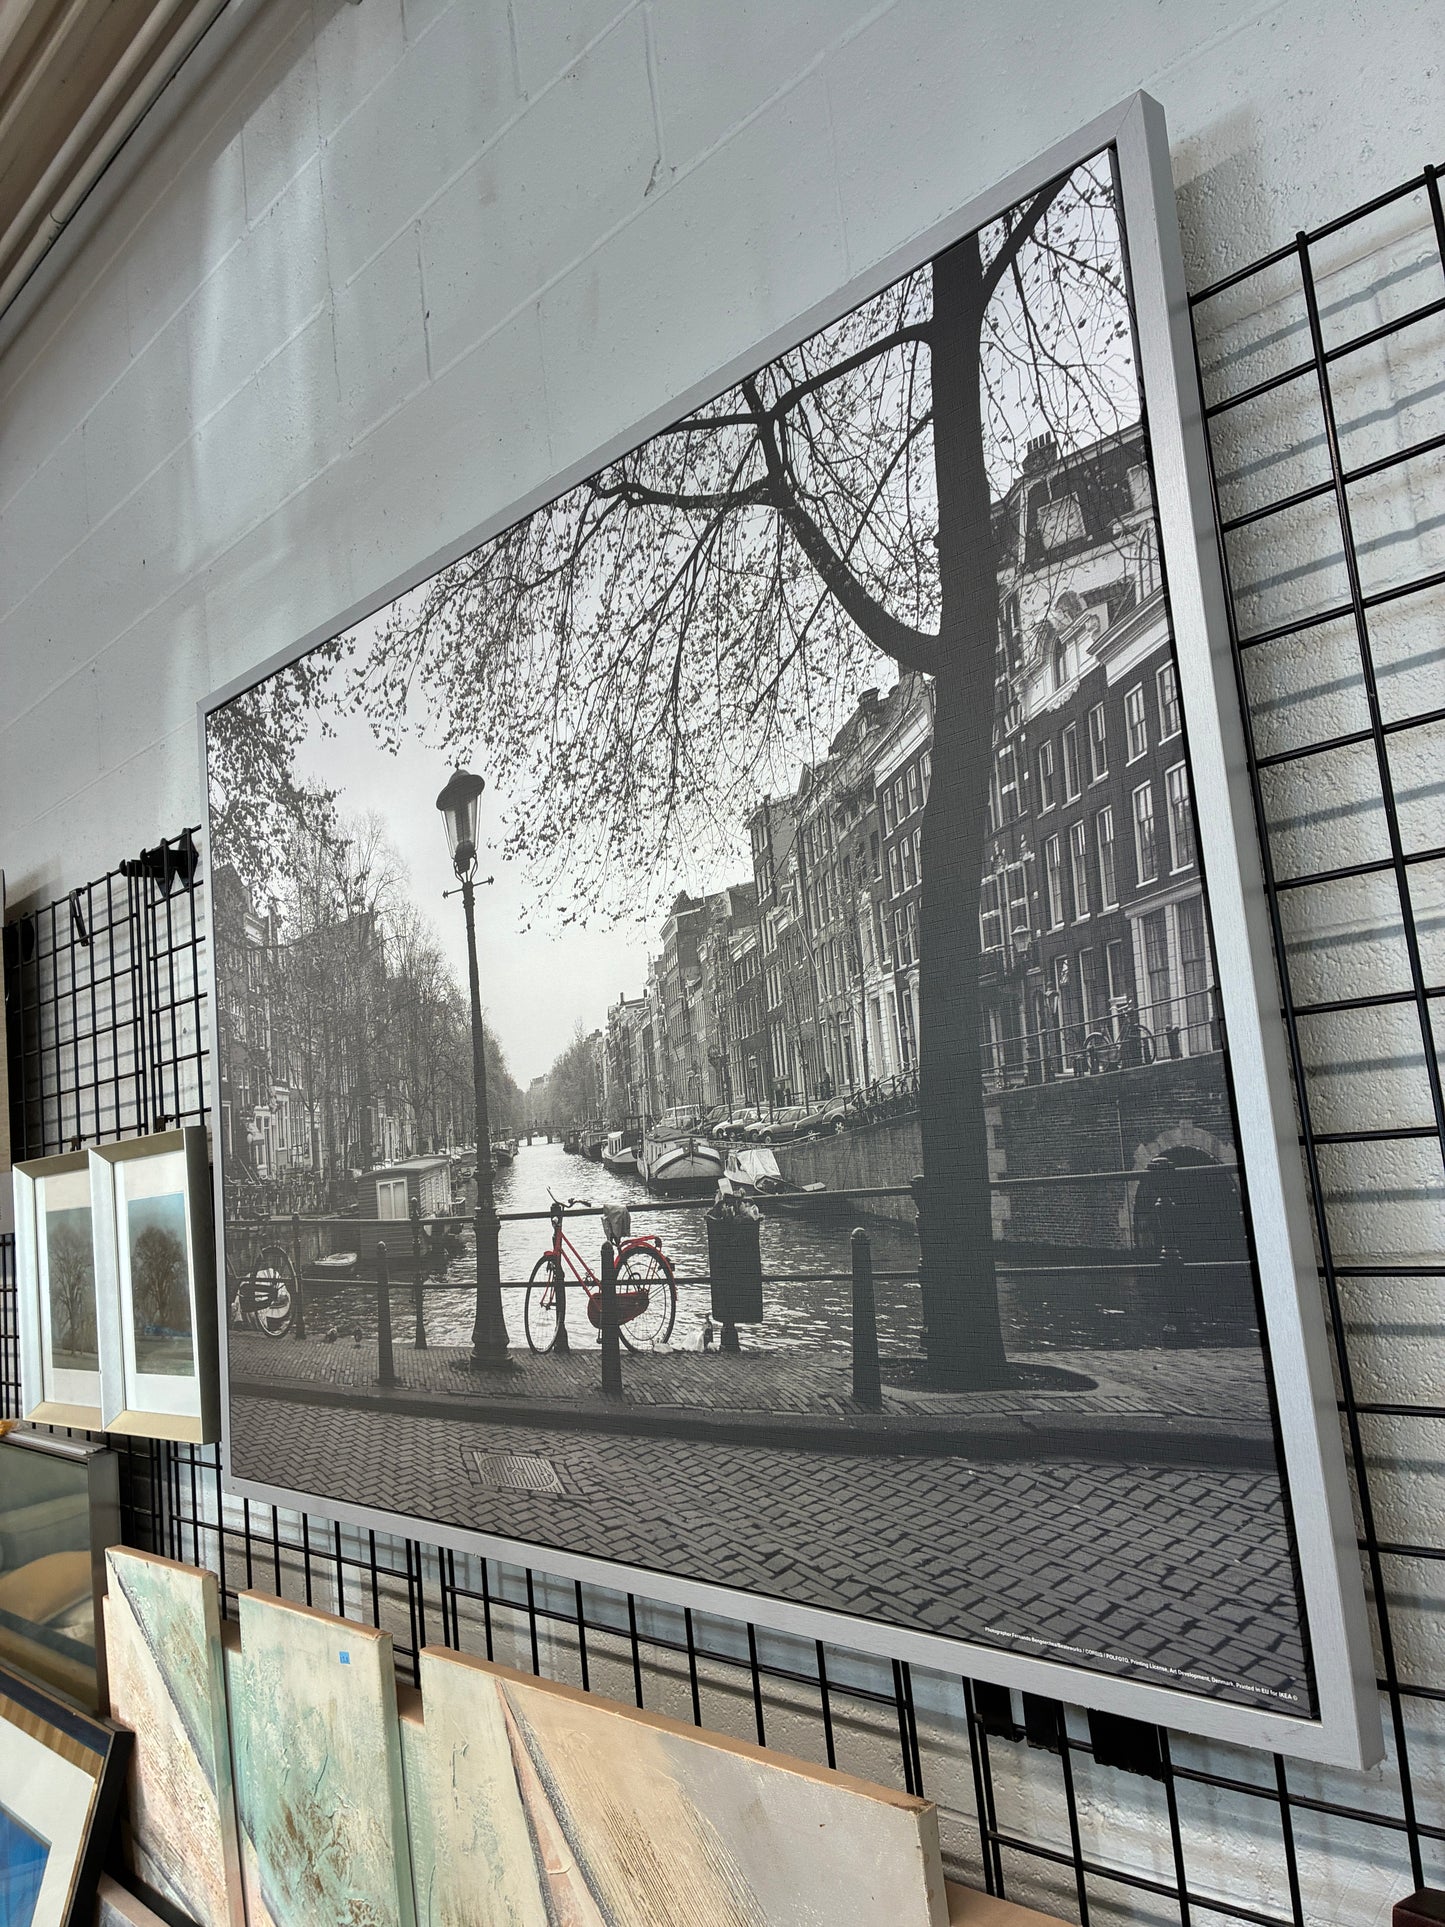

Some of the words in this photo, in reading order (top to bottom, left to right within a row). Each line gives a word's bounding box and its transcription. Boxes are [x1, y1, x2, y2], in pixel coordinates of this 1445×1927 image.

[1130, 1658, 1149, 1669] Printing
[1235, 1682, 1255, 1692] Printed
[1278, 1692, 1292, 1700] IKEA
